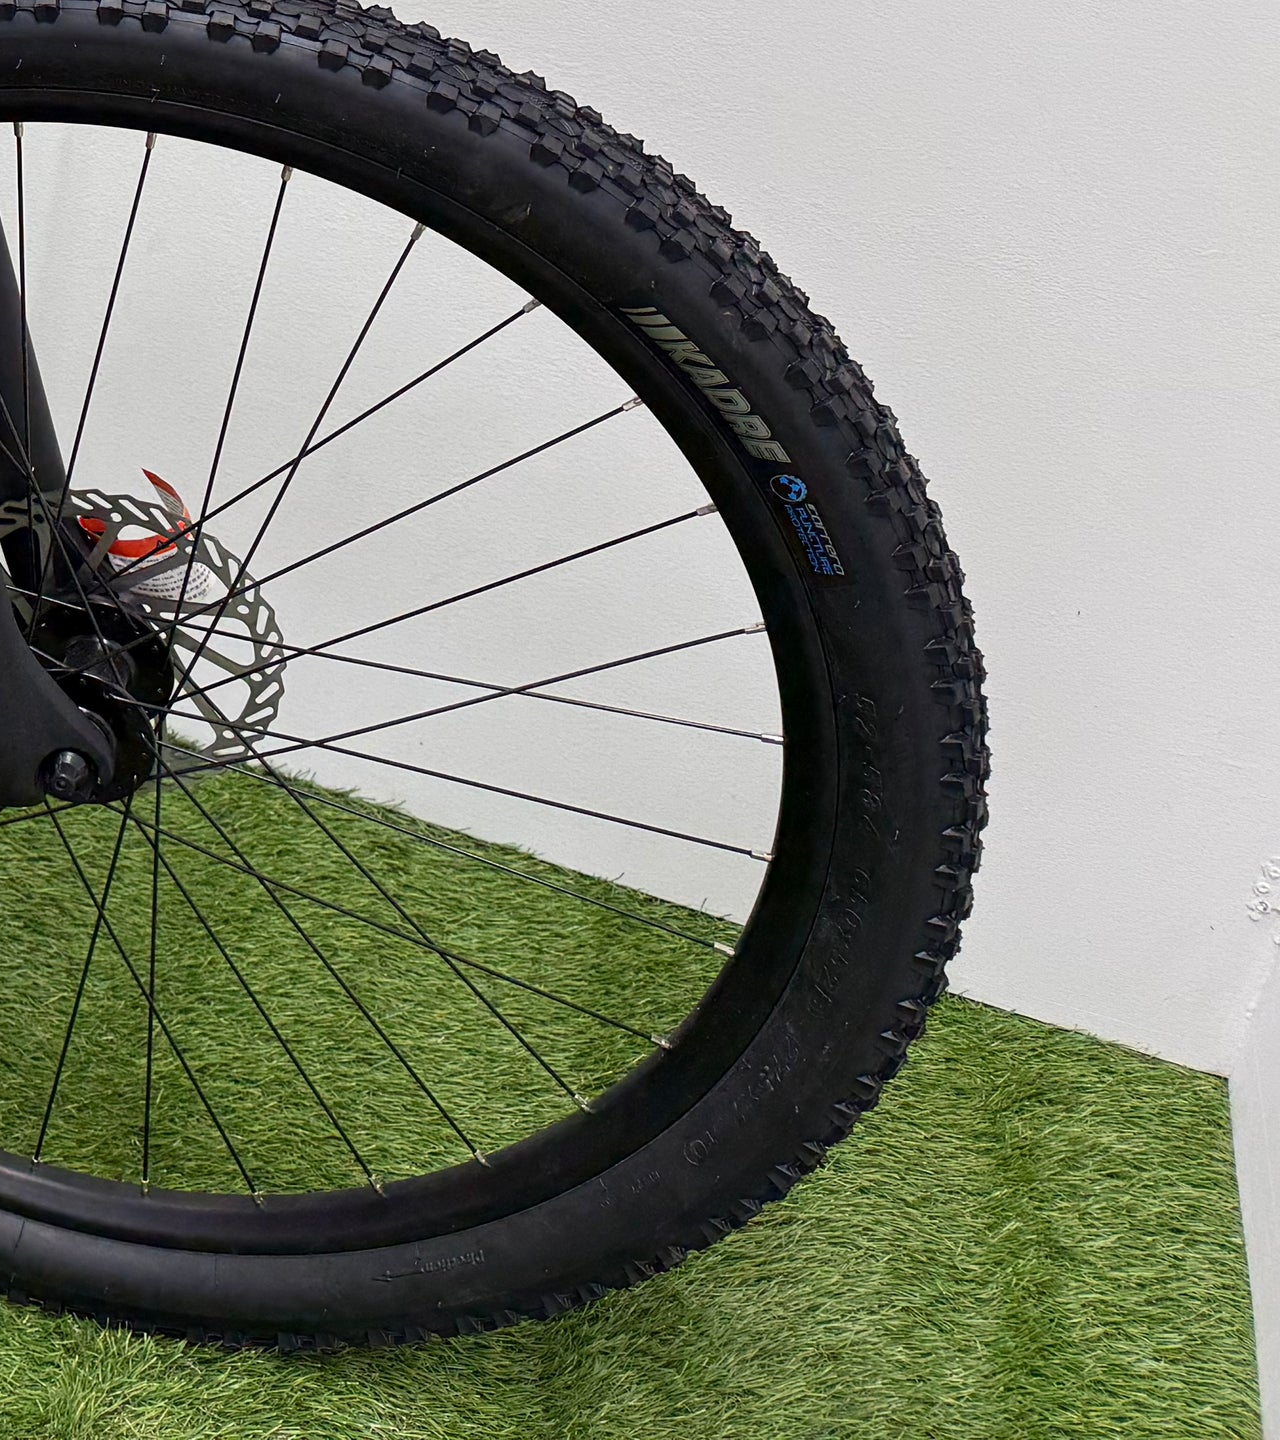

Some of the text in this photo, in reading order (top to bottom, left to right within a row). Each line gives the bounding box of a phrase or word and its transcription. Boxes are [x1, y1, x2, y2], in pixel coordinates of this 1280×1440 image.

[656, 340, 792, 463] KADRE
[784, 504, 821, 575] PROTECTION
[795, 506, 834, 577] PUNCTURE
